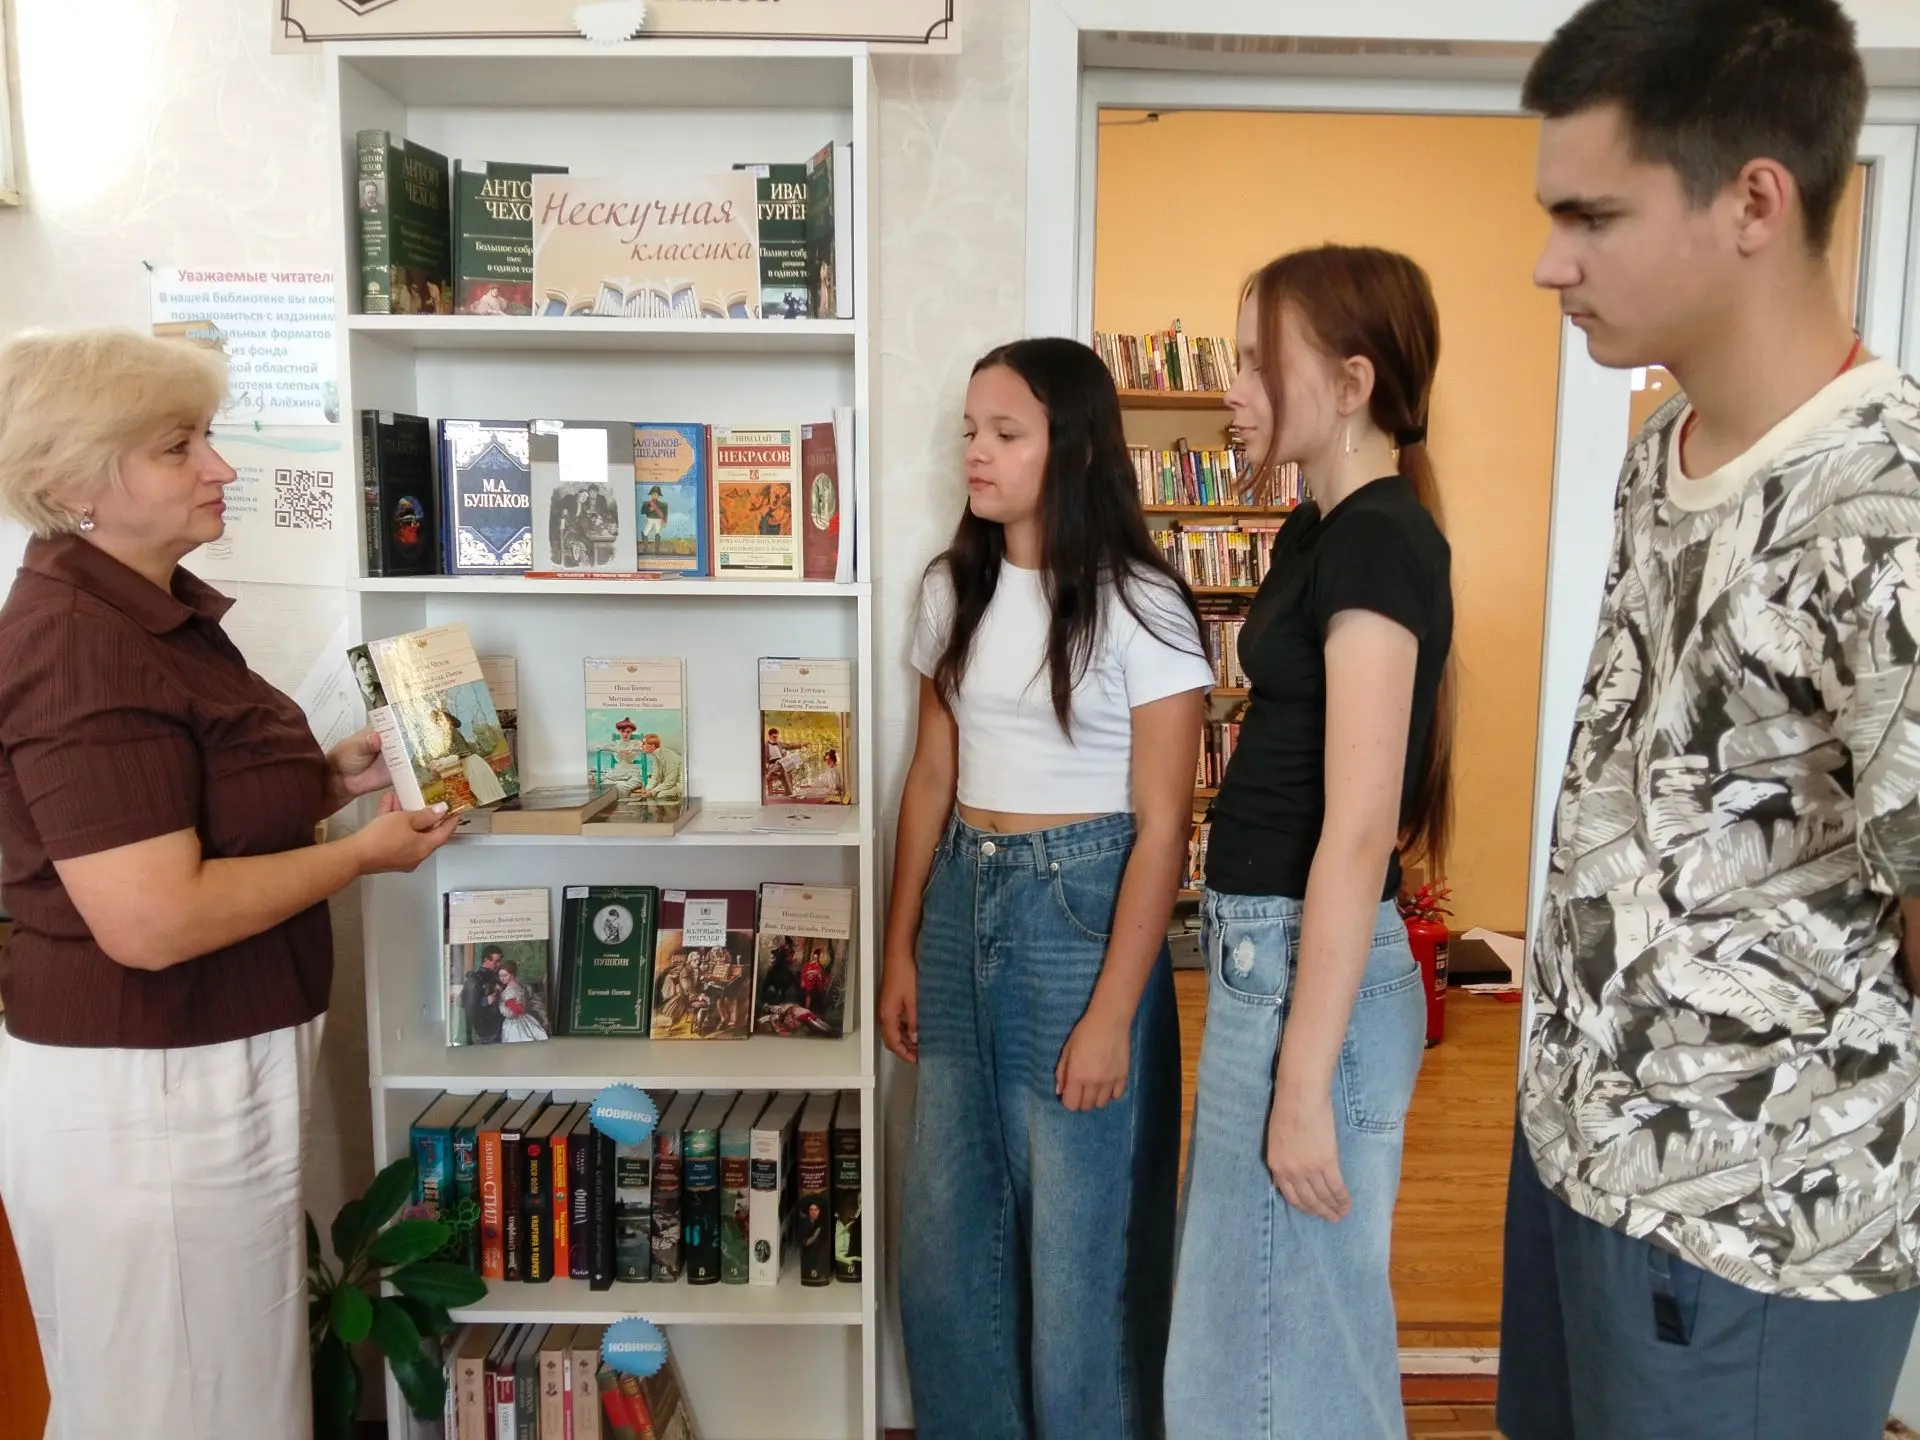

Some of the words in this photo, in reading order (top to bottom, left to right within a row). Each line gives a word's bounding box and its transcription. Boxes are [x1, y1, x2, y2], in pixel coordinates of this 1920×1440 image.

[541, 192, 734, 243] Нескучная
[631, 241, 753, 262] классика
[178, 269, 268, 283] Уважаемые
[158, 292, 168, 304] В
[170, 292, 209, 304] нашей
[212, 292, 285, 304] библиотеке
[288, 294, 305, 305] вы
[170, 310, 263, 322] познакомиться
[266, 312, 274, 322] с
[270, 329, 332, 342] форматов
[231, 346, 245, 355] из
[248, 345, 288, 358] фонда
[254, 362, 318, 374] областной
[275, 381, 320, 391] слепых
[269, 396, 321, 408] Алёхина
[719, 449, 790, 464] НЕКРАСОВ
[482, 478, 511, 493] М.А.
[464, 493, 530, 508] БУЛГАКОВ
[593, 957, 629, 967] ПУШКИН
[483, 1182, 498, 1225] СТИЛ
[574, 1189, 588, 1225] ФИНАЛ
